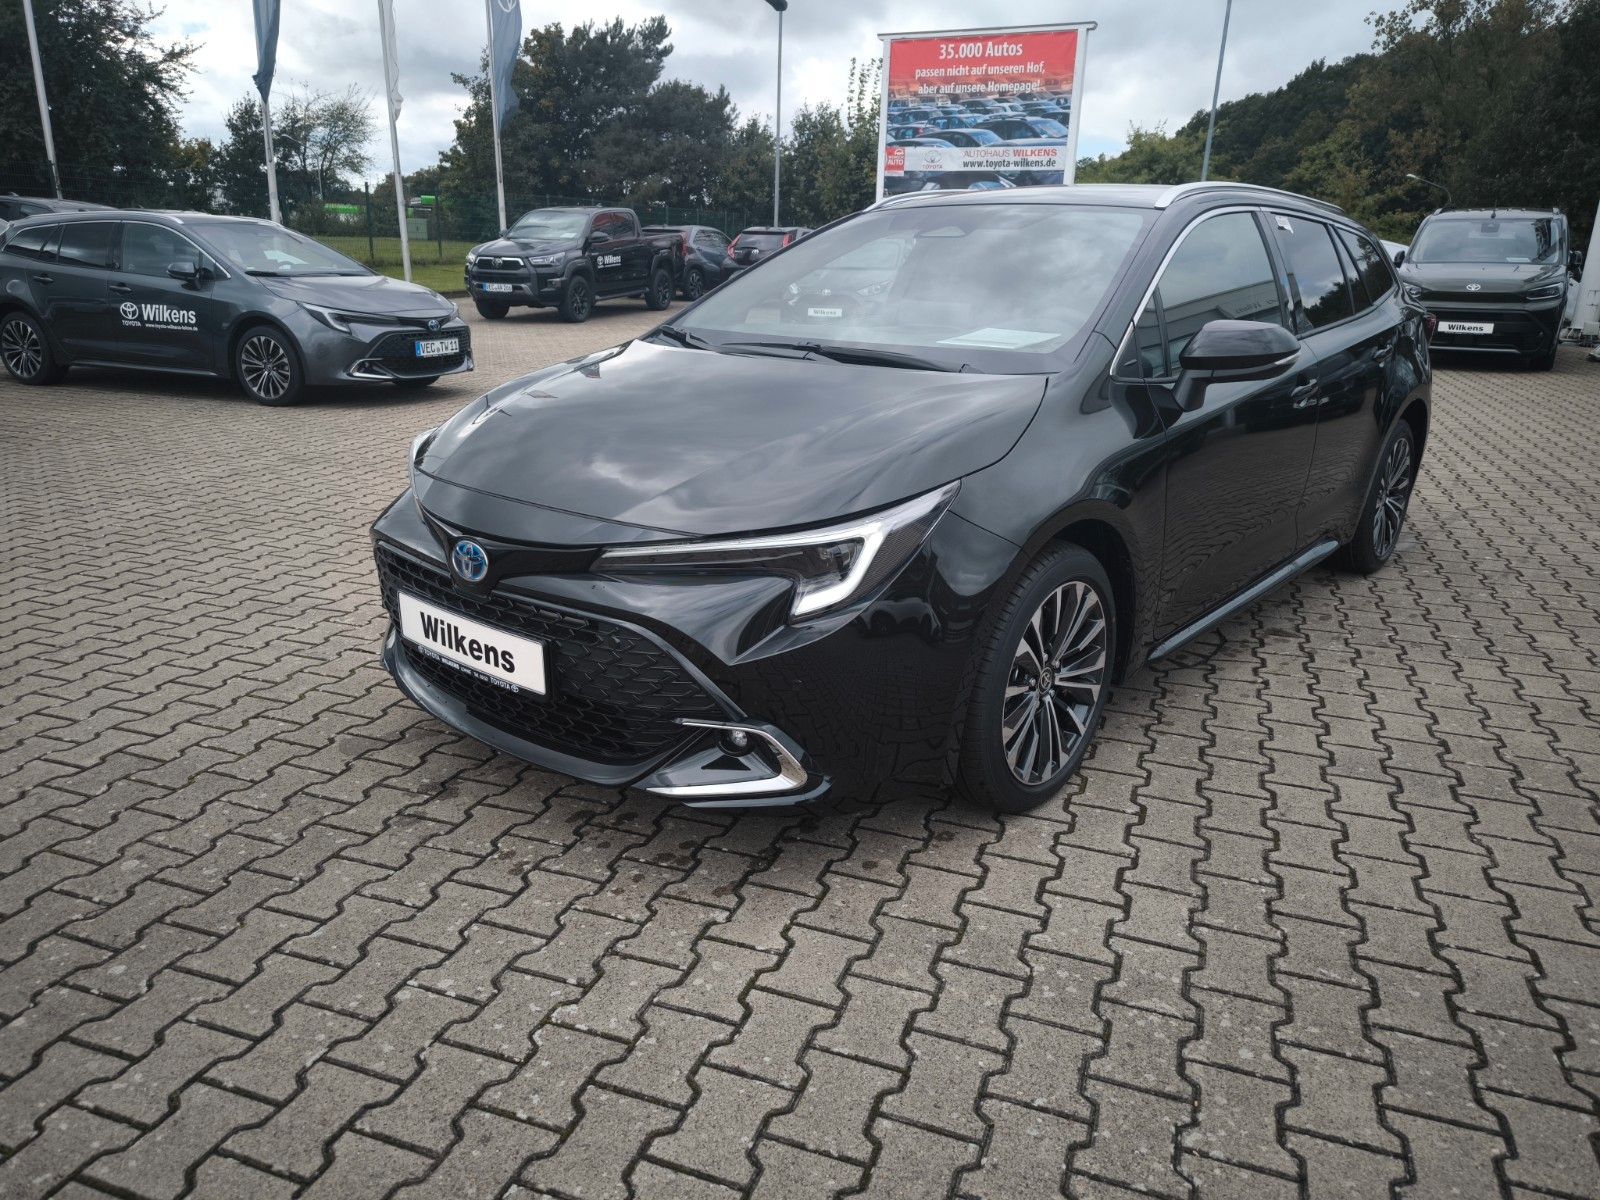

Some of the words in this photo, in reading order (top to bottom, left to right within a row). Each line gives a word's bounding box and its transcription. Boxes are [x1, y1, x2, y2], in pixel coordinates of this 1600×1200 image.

[939, 42, 983, 59] 35.000
[985, 41, 1023, 57] Autos
[915, 68, 945, 80] passen
[947, 65, 970, 76] nicht
[971, 64, 988, 75] auf
[988, 64, 1025, 74] unseren
[1027, 61, 1046, 74] Hof,
[918, 83, 938, 94] aber
[939, 82, 956, 94] auf
[955, 83, 986, 93] unsere
[987, 80, 1041, 93] Homepage!
[963, 149, 1010, 158] AUTOHAUS
[1013, 148, 1057, 157] WILKENS
[962, 158, 1056, 169] www.toyota-wilkens.de
[604, 255, 621, 264] Wilkens
[141, 304, 196, 324] Wilkens
[1448, 323, 1484, 331] Wilkens
[421, 342, 435, 354] VEC
[420, 611, 515, 673] Wilkens
[424, 649, 440, 661] TOYOTA
[490, 676, 511, 691] TOYOTA
